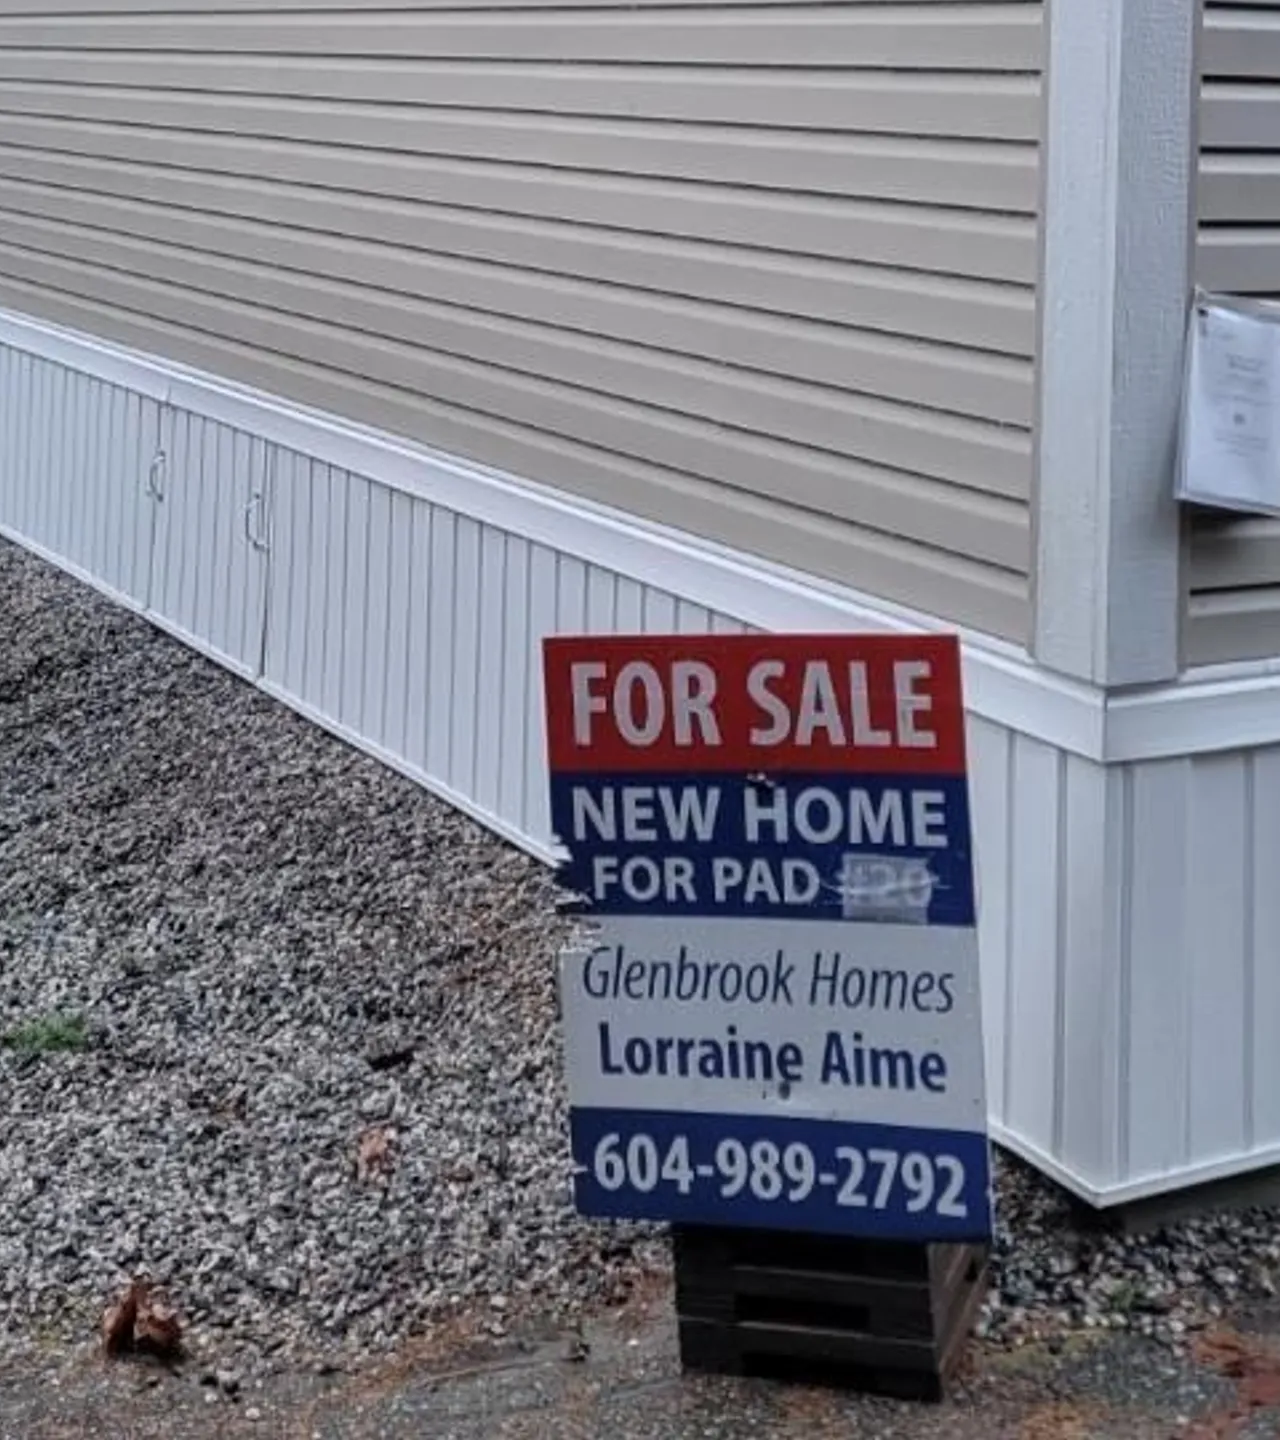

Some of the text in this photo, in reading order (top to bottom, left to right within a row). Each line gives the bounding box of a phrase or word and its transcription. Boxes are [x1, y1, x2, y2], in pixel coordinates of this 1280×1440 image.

[571, 661, 937, 748] FOR SALE
[572, 786, 948, 848] NEW HOME
[593, 857, 697, 902] FOR
[712, 859, 820, 904] PAD
[582, 944, 955, 1014] Glenbrook Homes
[598, 1022, 947, 1093] Lorraine Aime
[593, 1133, 968, 1218] 604-989-2792
